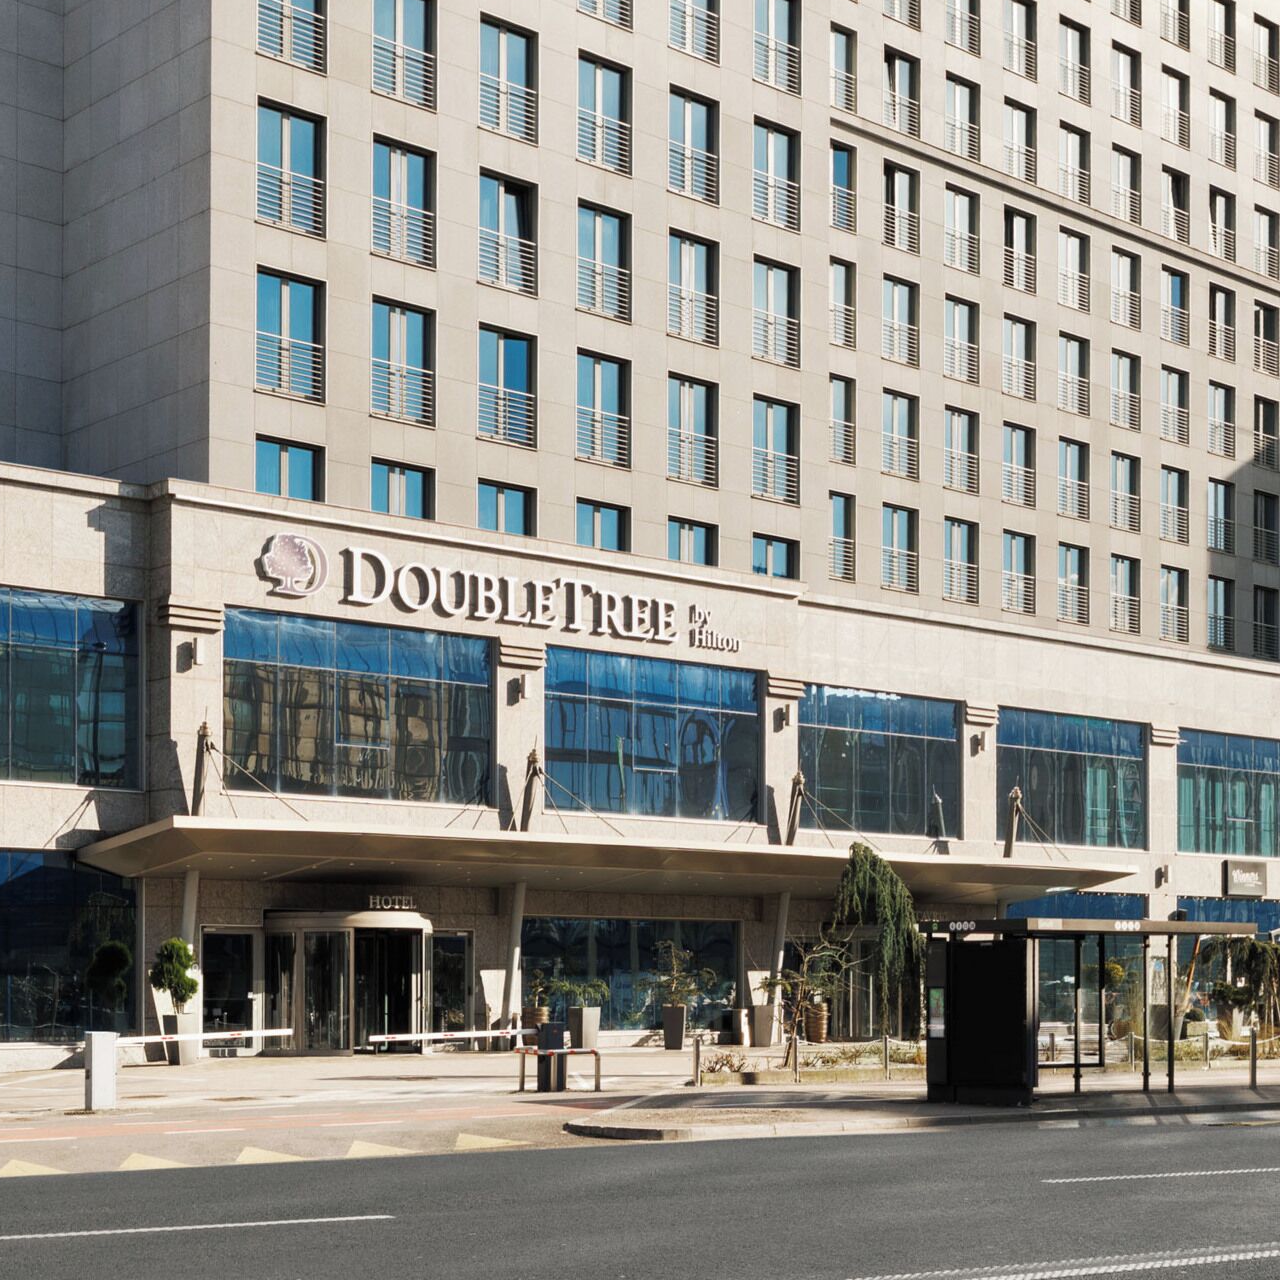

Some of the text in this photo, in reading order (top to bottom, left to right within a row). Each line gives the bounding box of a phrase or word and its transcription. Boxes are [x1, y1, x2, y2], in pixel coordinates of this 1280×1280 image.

[693, 604, 711, 628] by
[693, 628, 741, 652] Hilton
[368, 895, 417, 910] HOTEL
